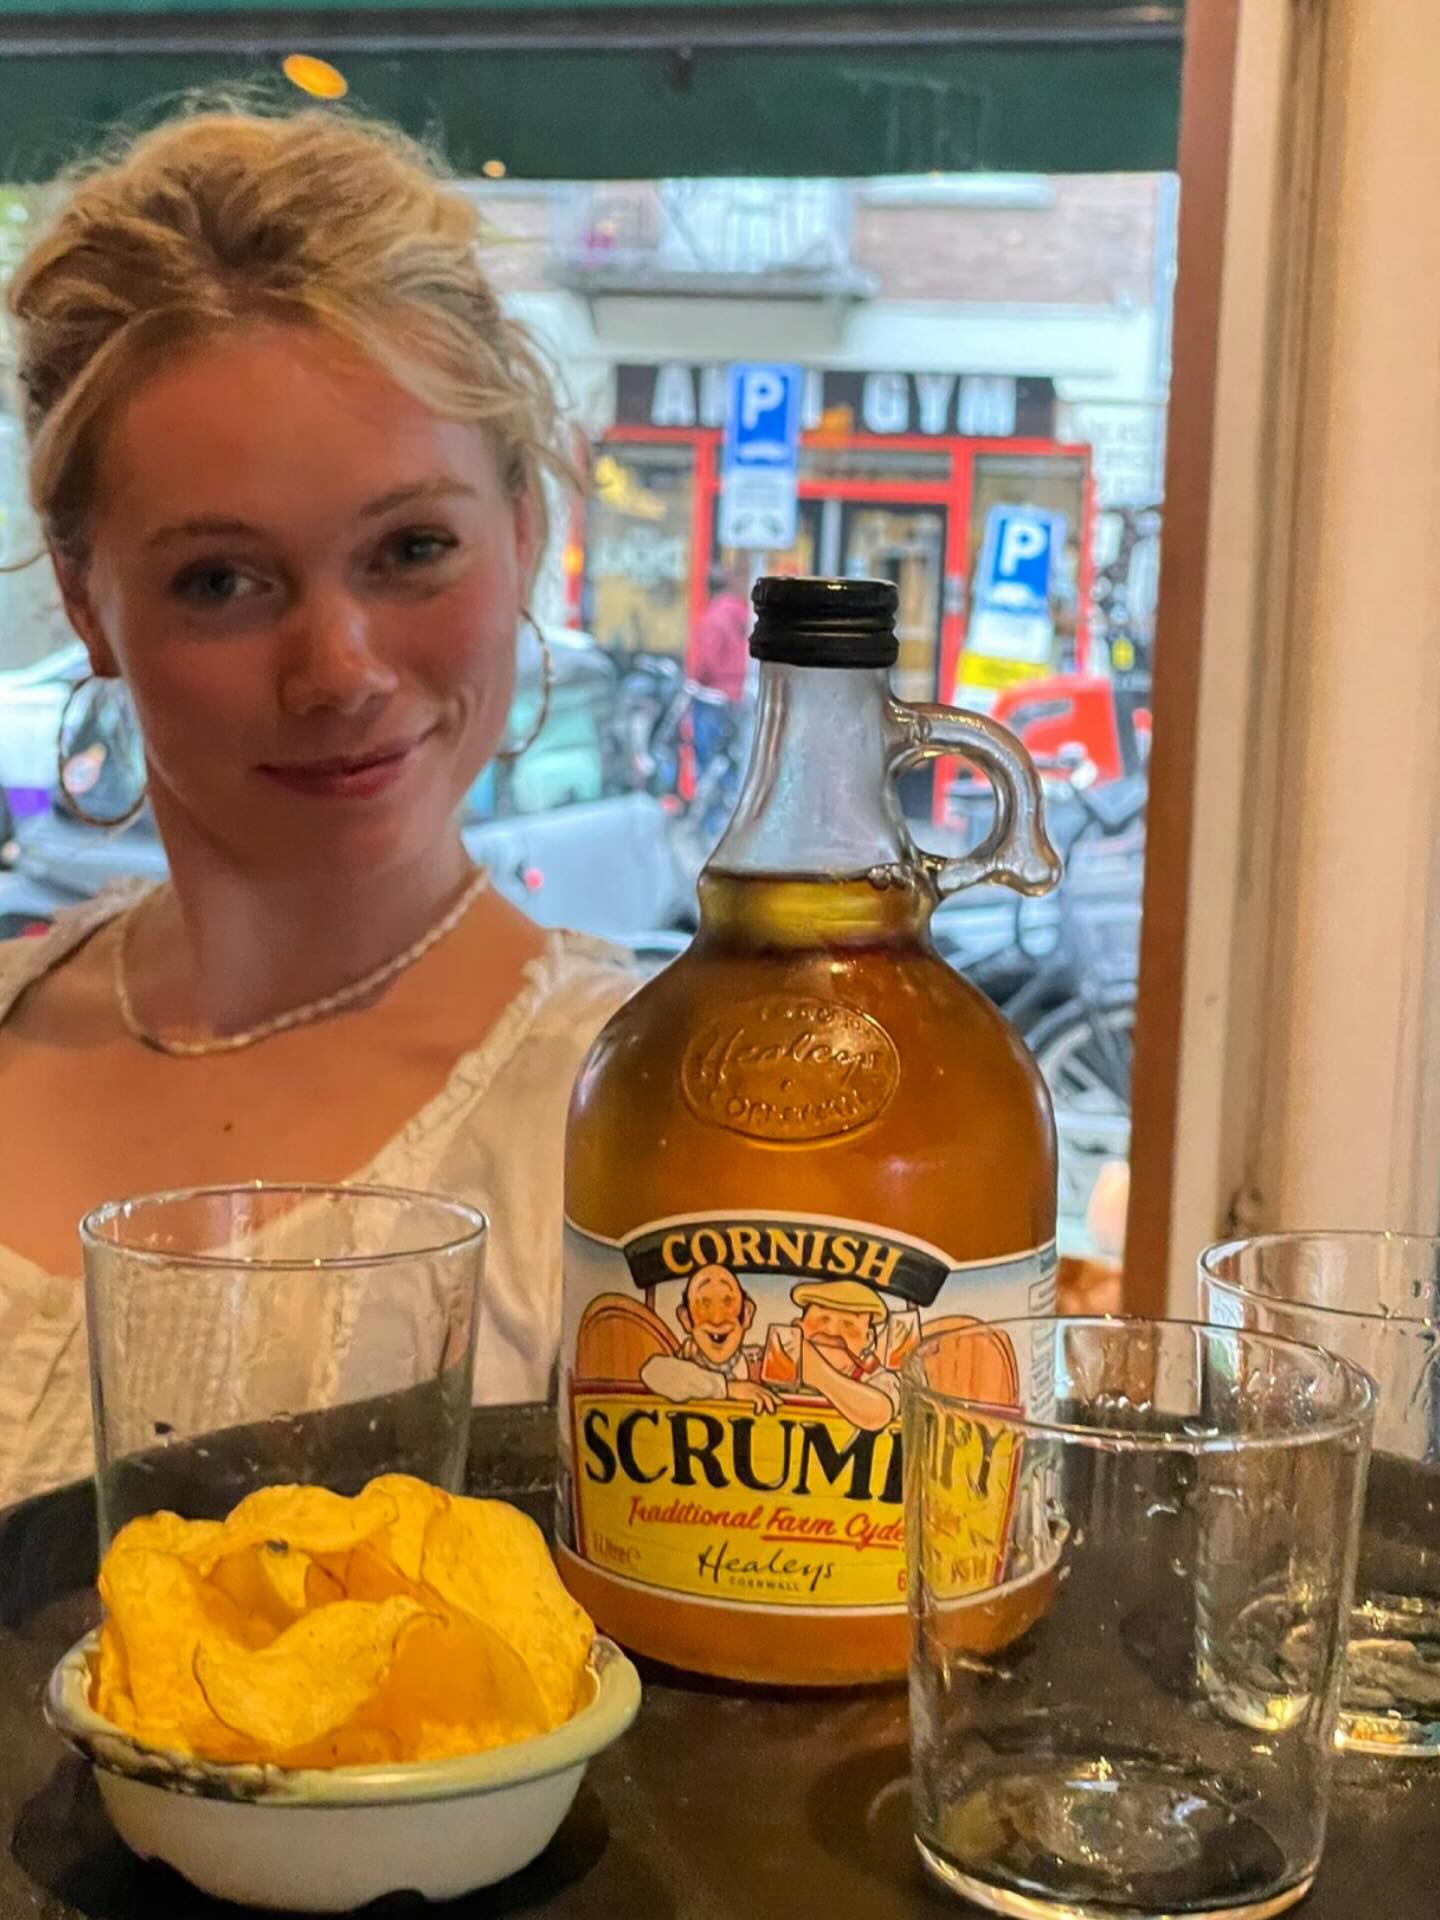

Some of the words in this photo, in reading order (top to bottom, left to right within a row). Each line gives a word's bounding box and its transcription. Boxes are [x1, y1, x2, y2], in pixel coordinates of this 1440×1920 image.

[741, 371, 785, 431] P
[862, 372, 1017, 437] GYM
[1000, 519, 1048, 576] P
[661, 1225, 903, 1286] CORNISH
[627, 1495, 764, 1531] Traditional
[765, 1507, 838, 1537] Farm
[698, 1541, 835, 1592] Healeys
